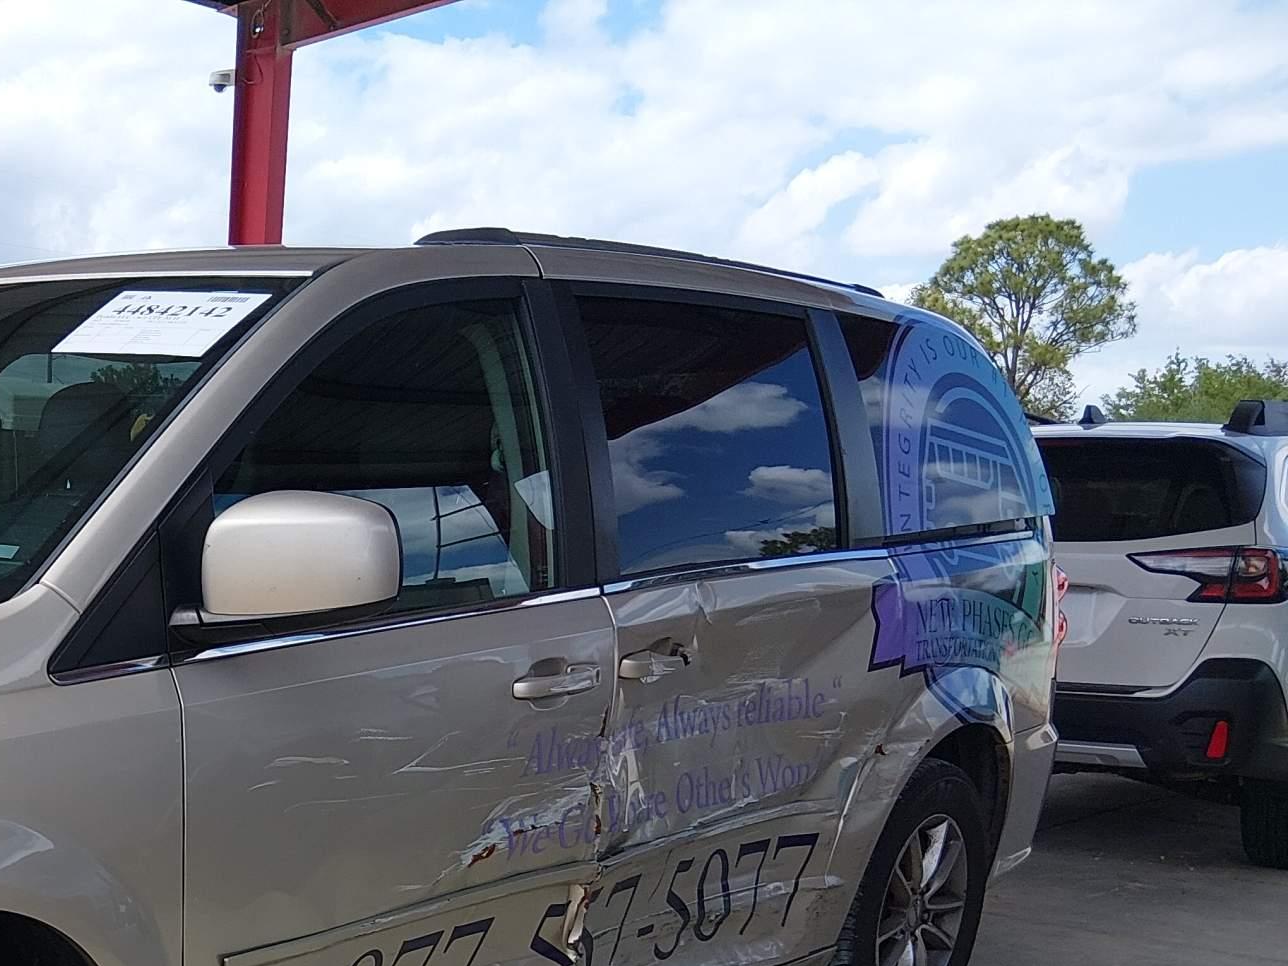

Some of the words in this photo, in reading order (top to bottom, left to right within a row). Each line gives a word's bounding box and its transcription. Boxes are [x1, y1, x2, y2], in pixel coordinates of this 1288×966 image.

[112, 303, 233, 318] 44842142
[919, 338, 938, 365] IS
[942, 334, 980, 369] OUR
[656, 694, 731, 748] Always
